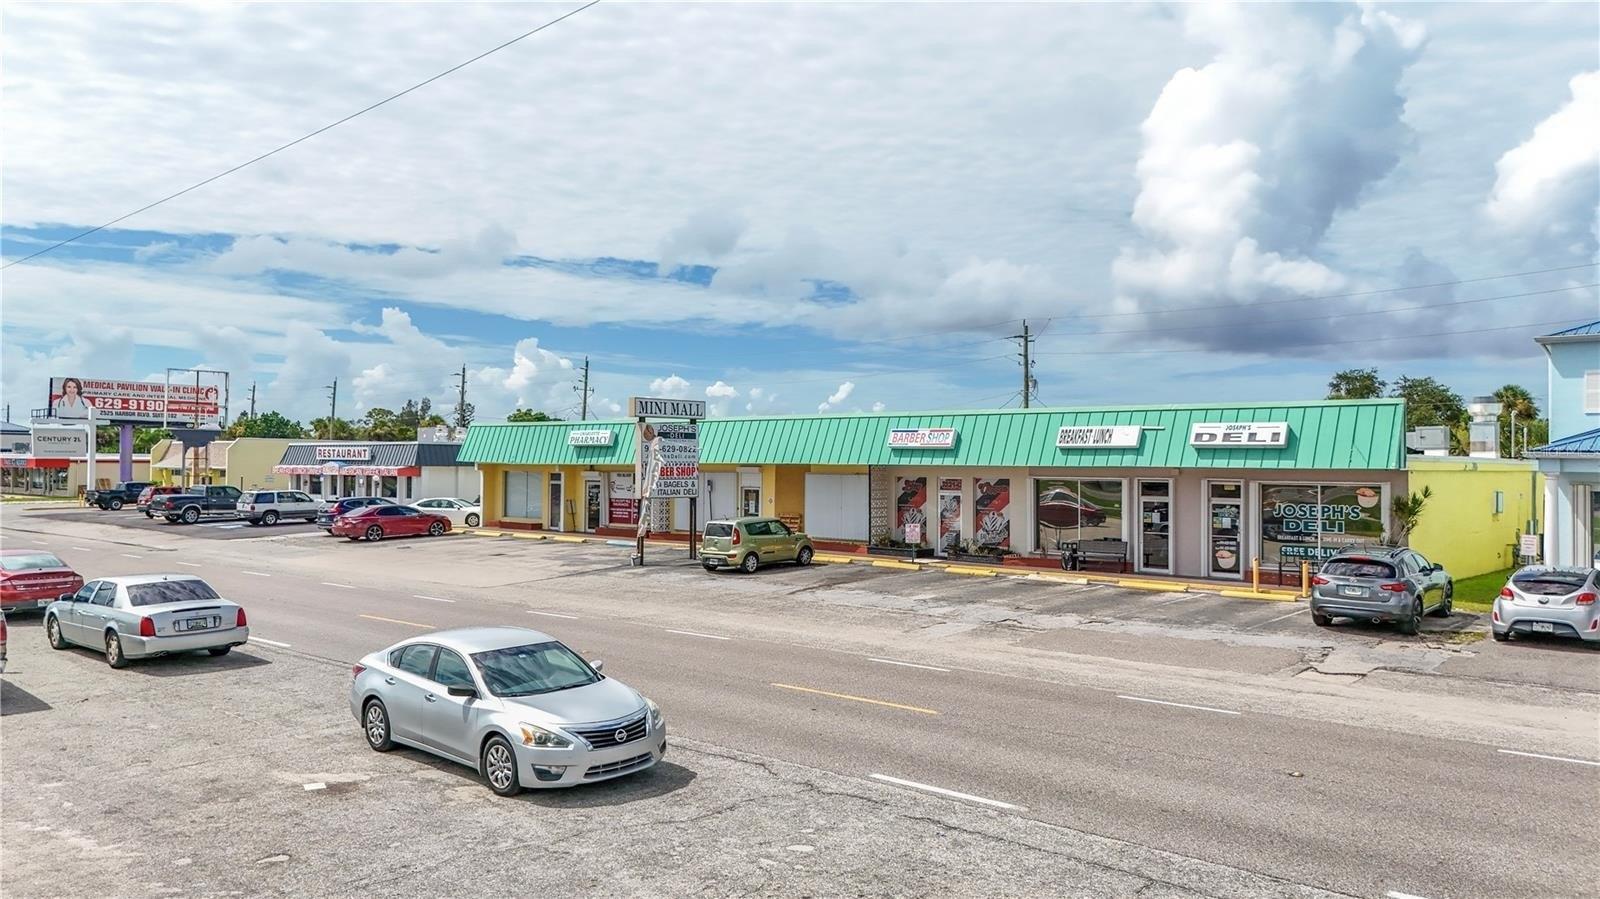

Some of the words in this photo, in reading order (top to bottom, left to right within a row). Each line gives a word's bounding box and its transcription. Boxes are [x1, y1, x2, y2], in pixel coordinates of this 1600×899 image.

[83, 381, 115, 390] MEDICAL
[117, 383, 149, 391] PAVILION
[151, 385, 180, 393] WAL-IN
[94, 397, 164, 411] 629-9190
[639, 400, 667, 415] MINI
[670, 403, 703, 417] MALL
[657, 424, 697, 432] JOSEPH'S
[891, 433, 926, 443] BARBER
[927, 433, 950, 443] SHOP
[1059, 429, 1093, 444] BREAKFAST
[1093, 429, 1113, 444] LUNCH
[1194, 432, 1281, 443] DELI
[317, 449, 367, 458] RESTAURANT
[675, 466, 696, 477] SHOP
[1273, 503, 1362, 520] JOSEPH'S
[1283, 519, 1345, 534] DELI
[1281, 546, 1305, 556] FREE
